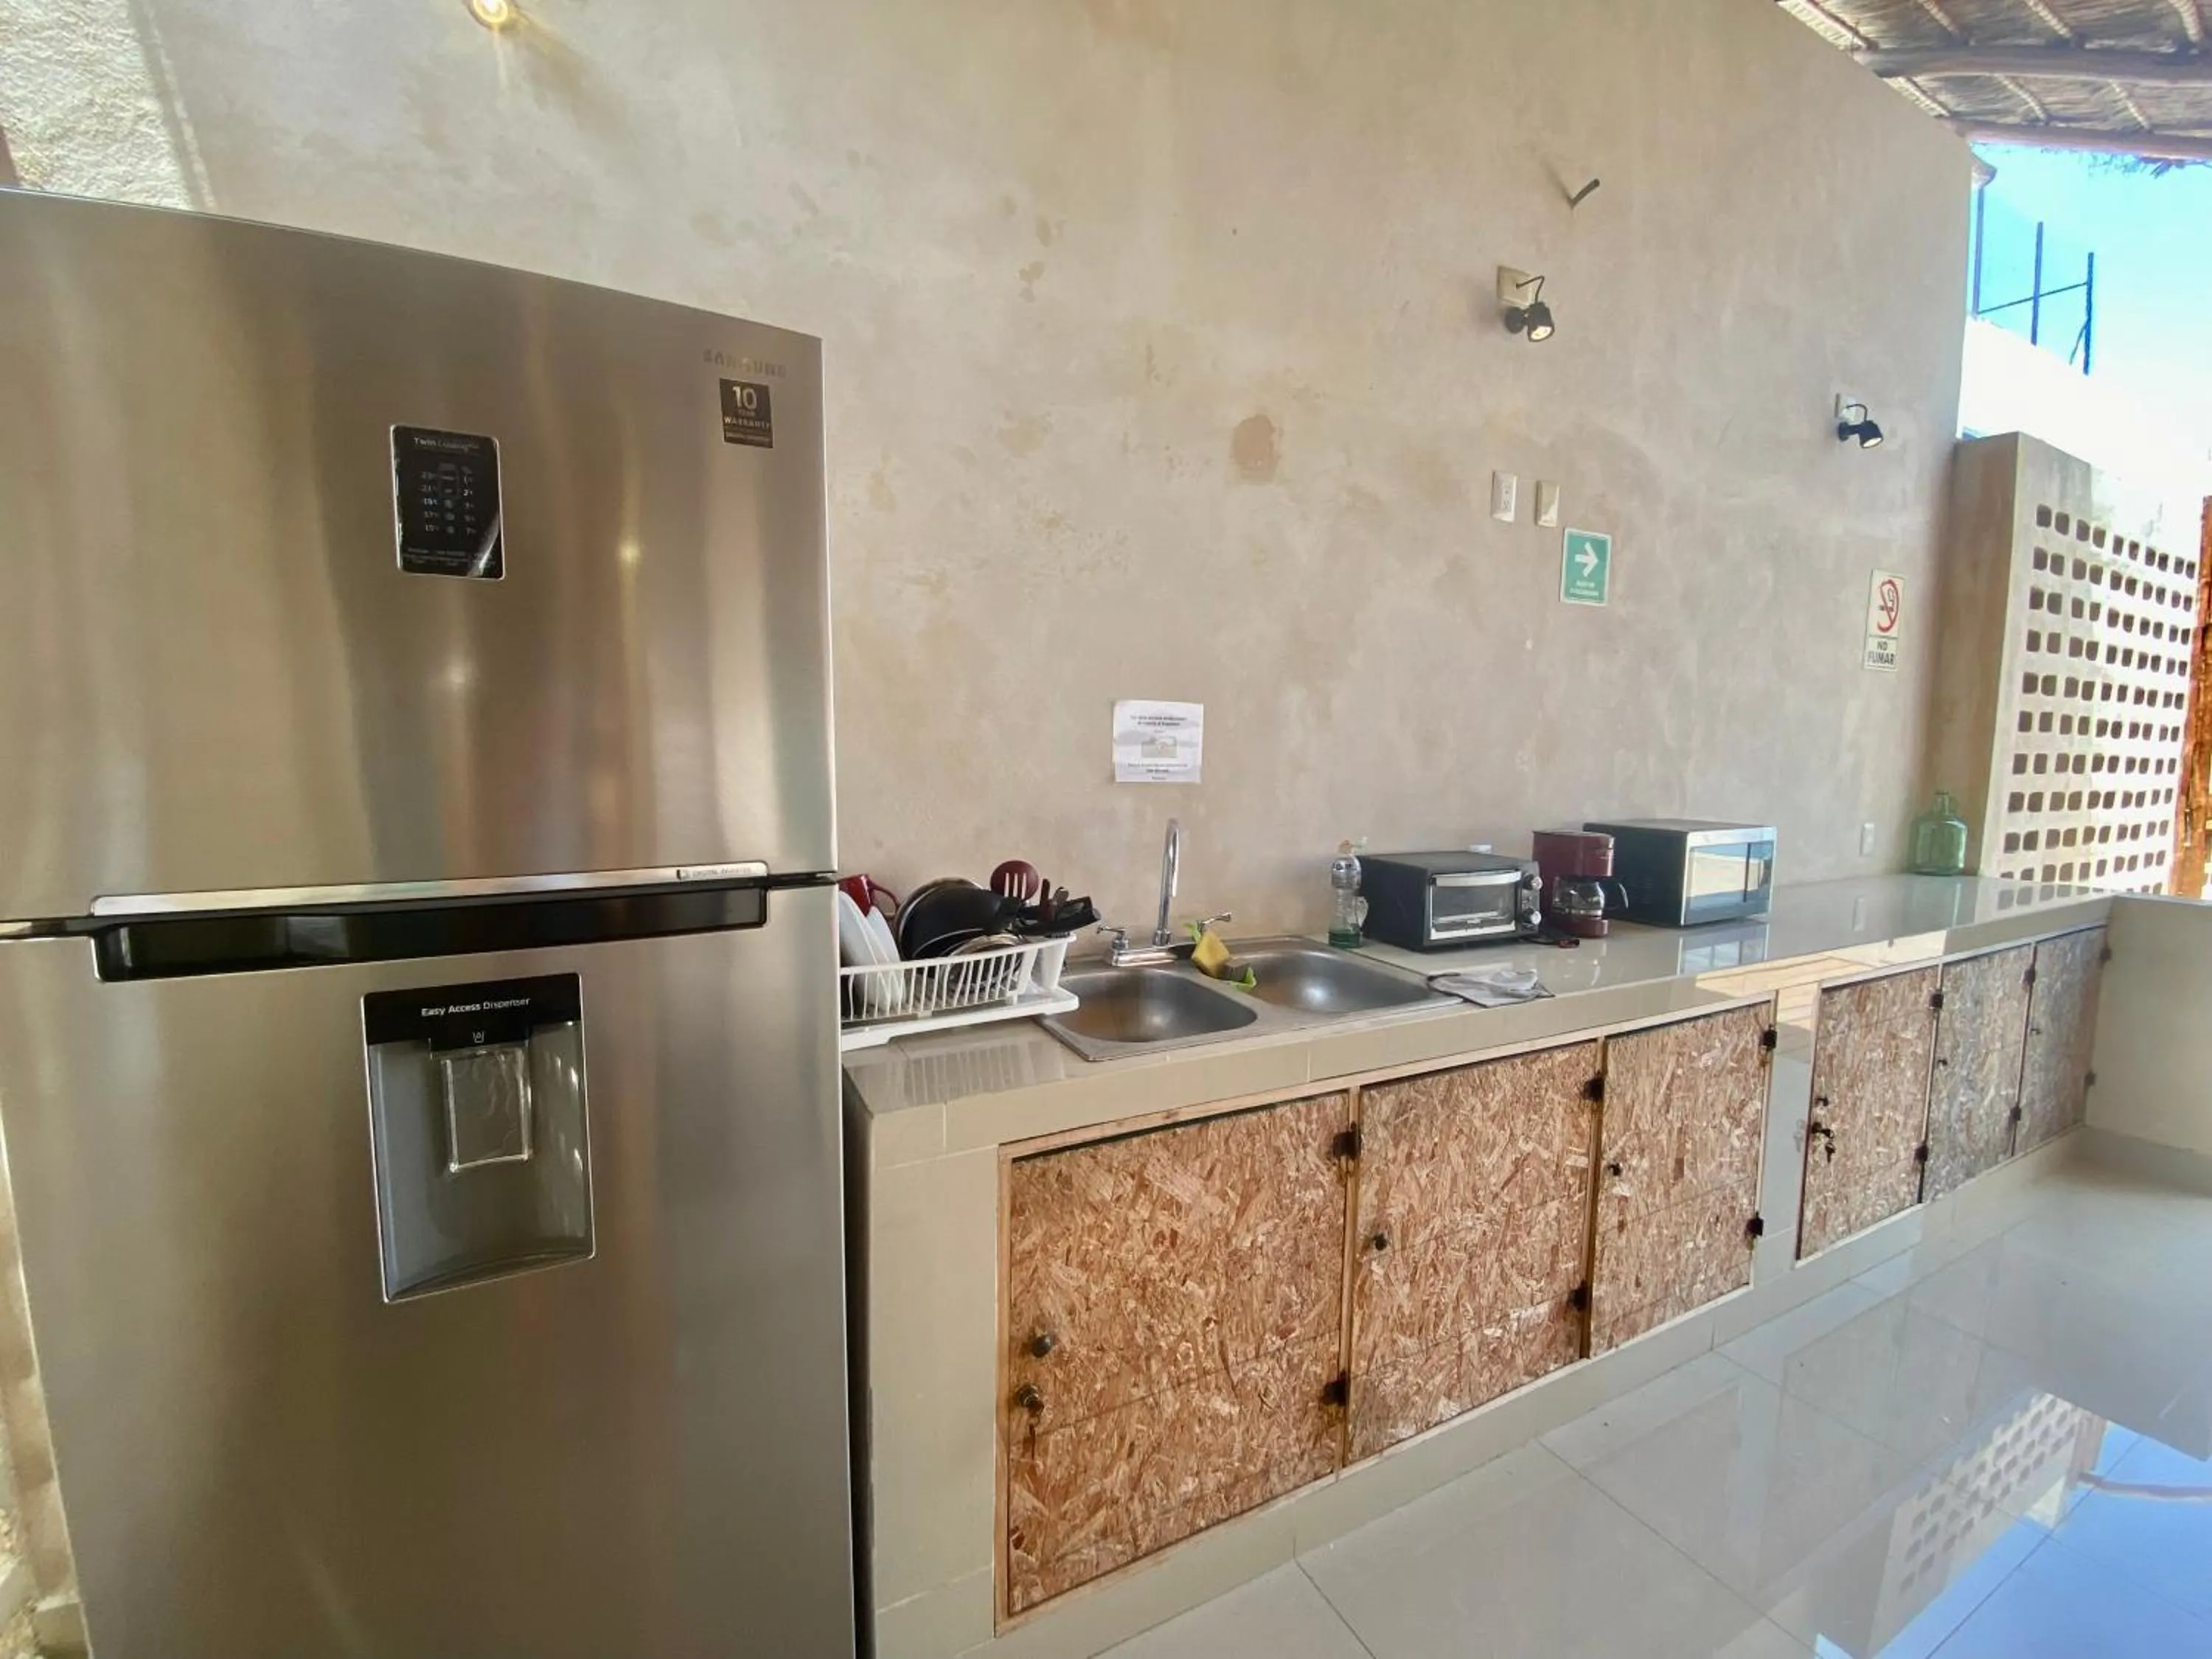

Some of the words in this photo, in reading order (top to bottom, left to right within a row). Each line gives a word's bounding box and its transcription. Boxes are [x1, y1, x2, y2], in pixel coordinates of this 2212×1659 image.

[732, 386, 757, 410] 10
[1877, 640, 1888, 651] NO
[1868, 651, 1893, 664] FUMAR
[421, 1007, 445, 1017] Easy
[448, 1003, 481, 1014] Access
[483, 998, 530, 1011] Dispenser
